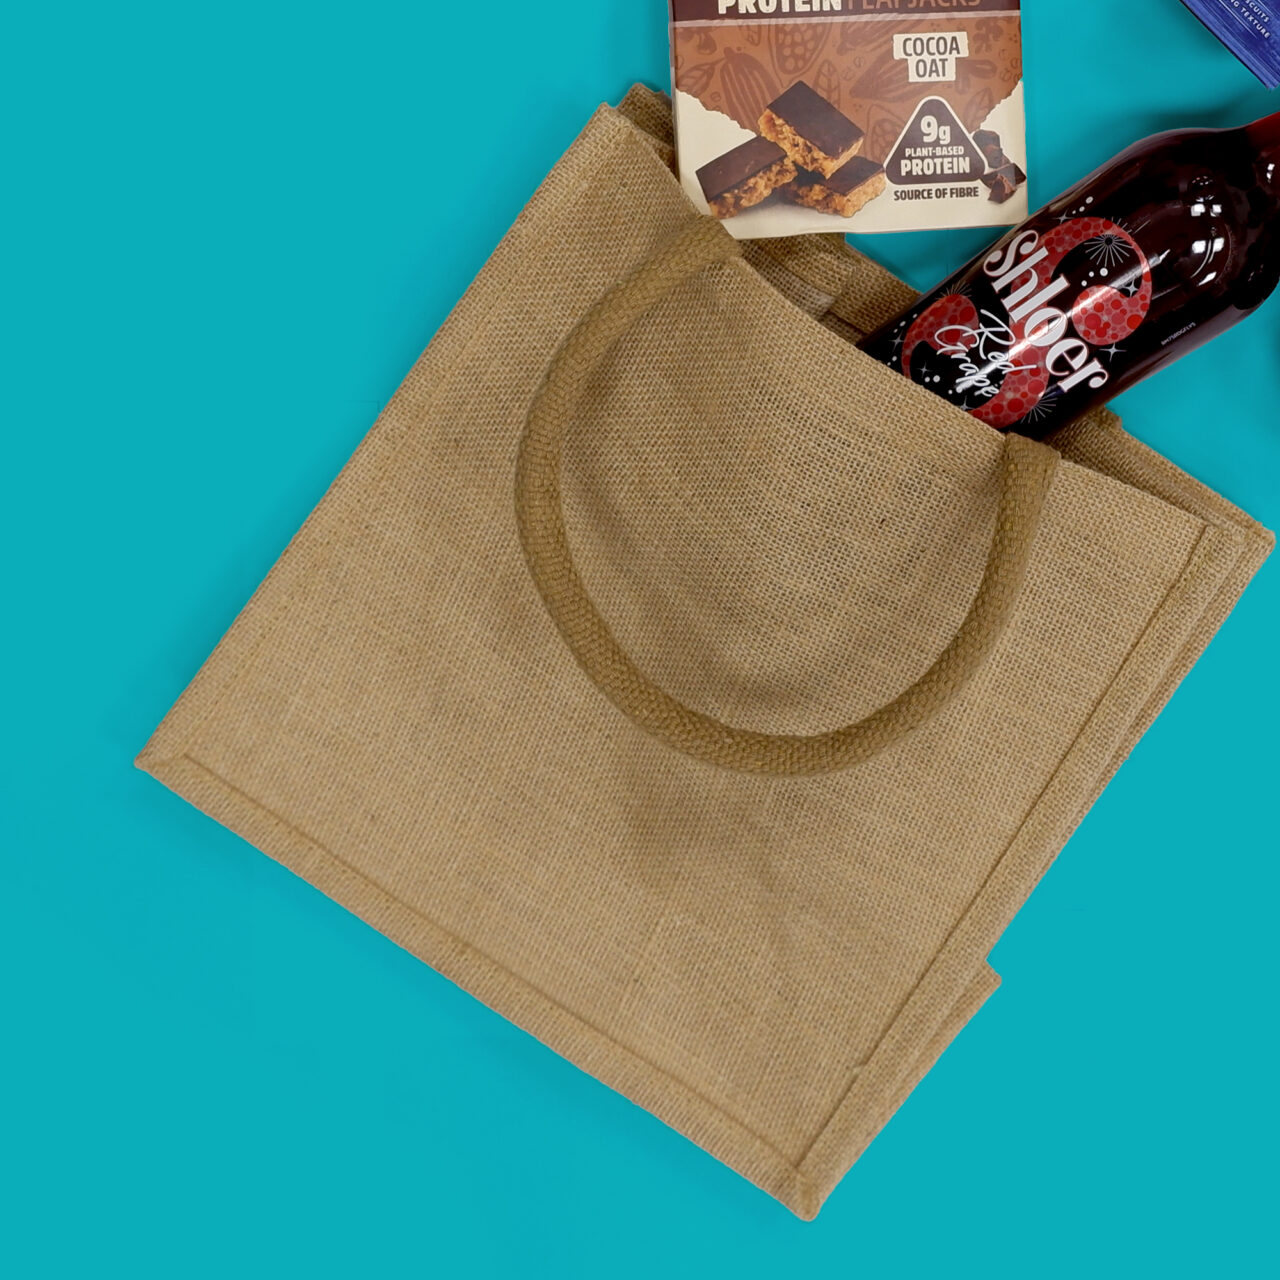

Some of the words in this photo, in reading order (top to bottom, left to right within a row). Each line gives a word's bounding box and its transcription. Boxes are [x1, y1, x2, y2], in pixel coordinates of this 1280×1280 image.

[1240, 7, 1271, 39] TEXTURE
[902, 36, 961, 57] COCOA
[915, 58, 949, 78] OAT
[920, 115, 951, 145] 9g
[905, 146, 965, 158] PLANT-BASED
[900, 157, 971, 177] PROTEIN
[893, 188, 933, 201] SOURCE
[935, 187, 948, 199] OF
[949, 186, 979, 198] FIBRE
[983, 229, 1109, 394] Shloer
